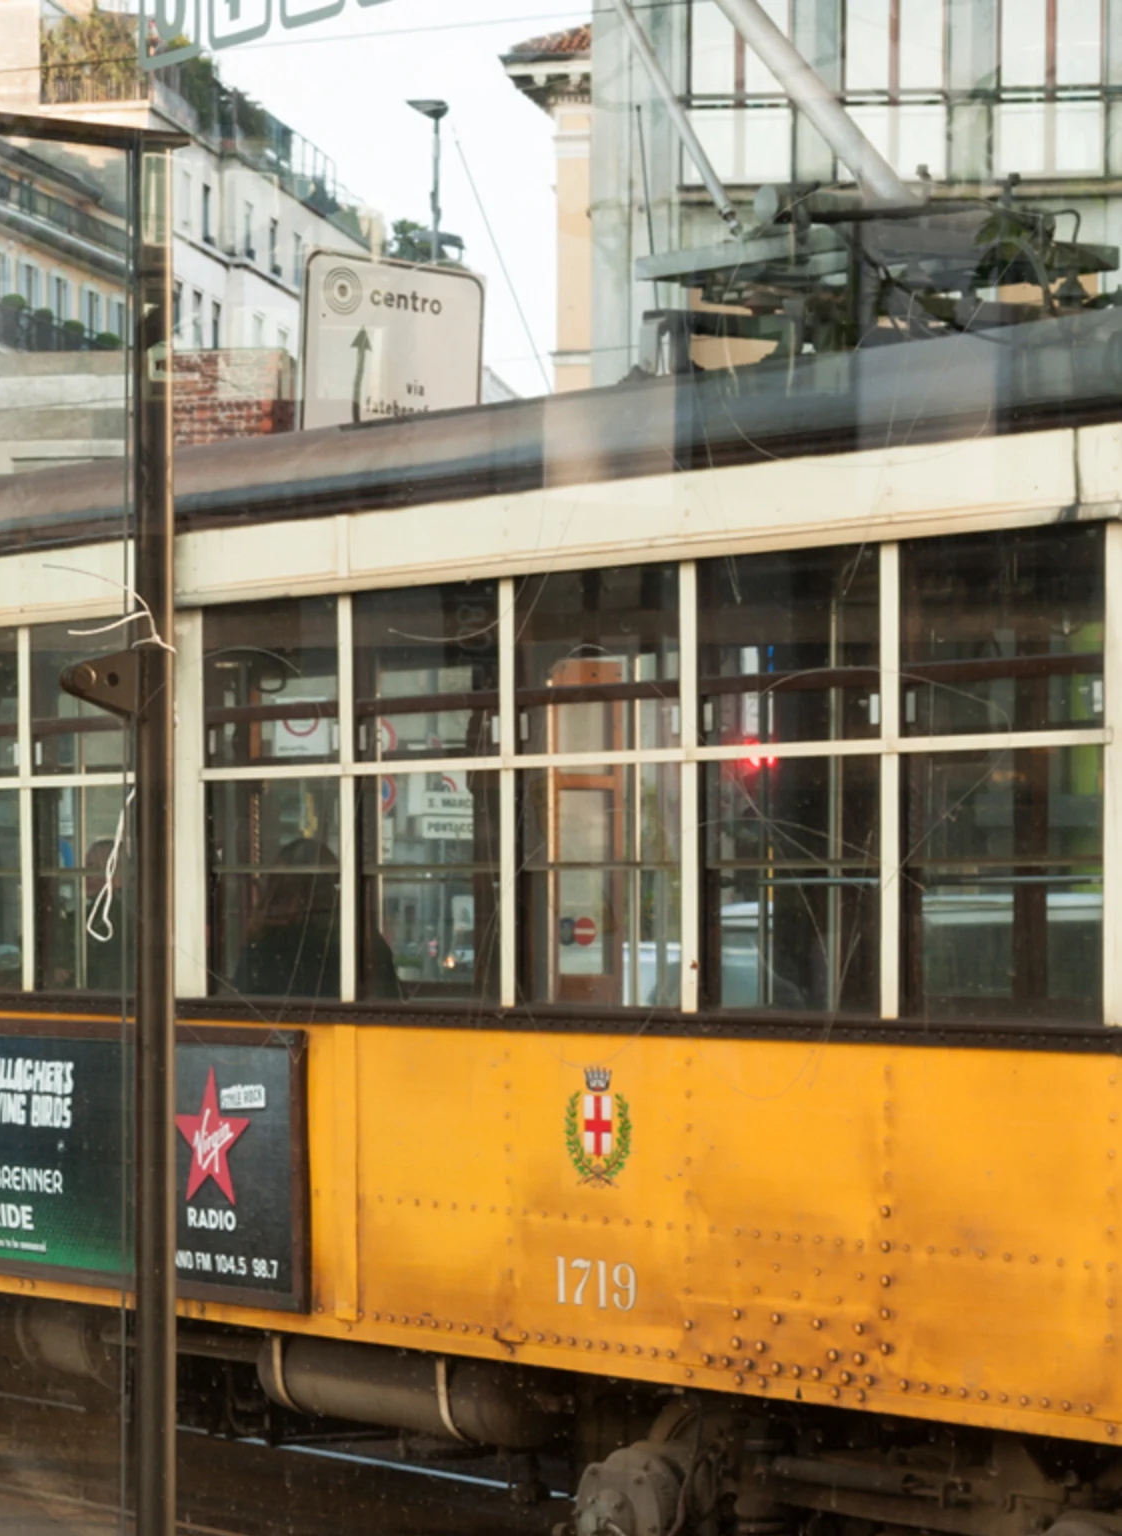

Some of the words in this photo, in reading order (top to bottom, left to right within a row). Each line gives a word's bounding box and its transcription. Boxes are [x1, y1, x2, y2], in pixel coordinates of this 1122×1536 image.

[370, 288, 443, 316] centro
[405, 380, 426, 398] via
[30, 1094, 73, 1129] BIRDS
[193, 1107, 235, 1174] Virgin
[186, 1206, 237, 1231] RADIO
[195, 1251, 213, 1272] FM
[215, 1252, 247, 1276] 104.5
[251, 1257, 279, 1279] 98.7
[556, 1255, 637, 1311] 1719
